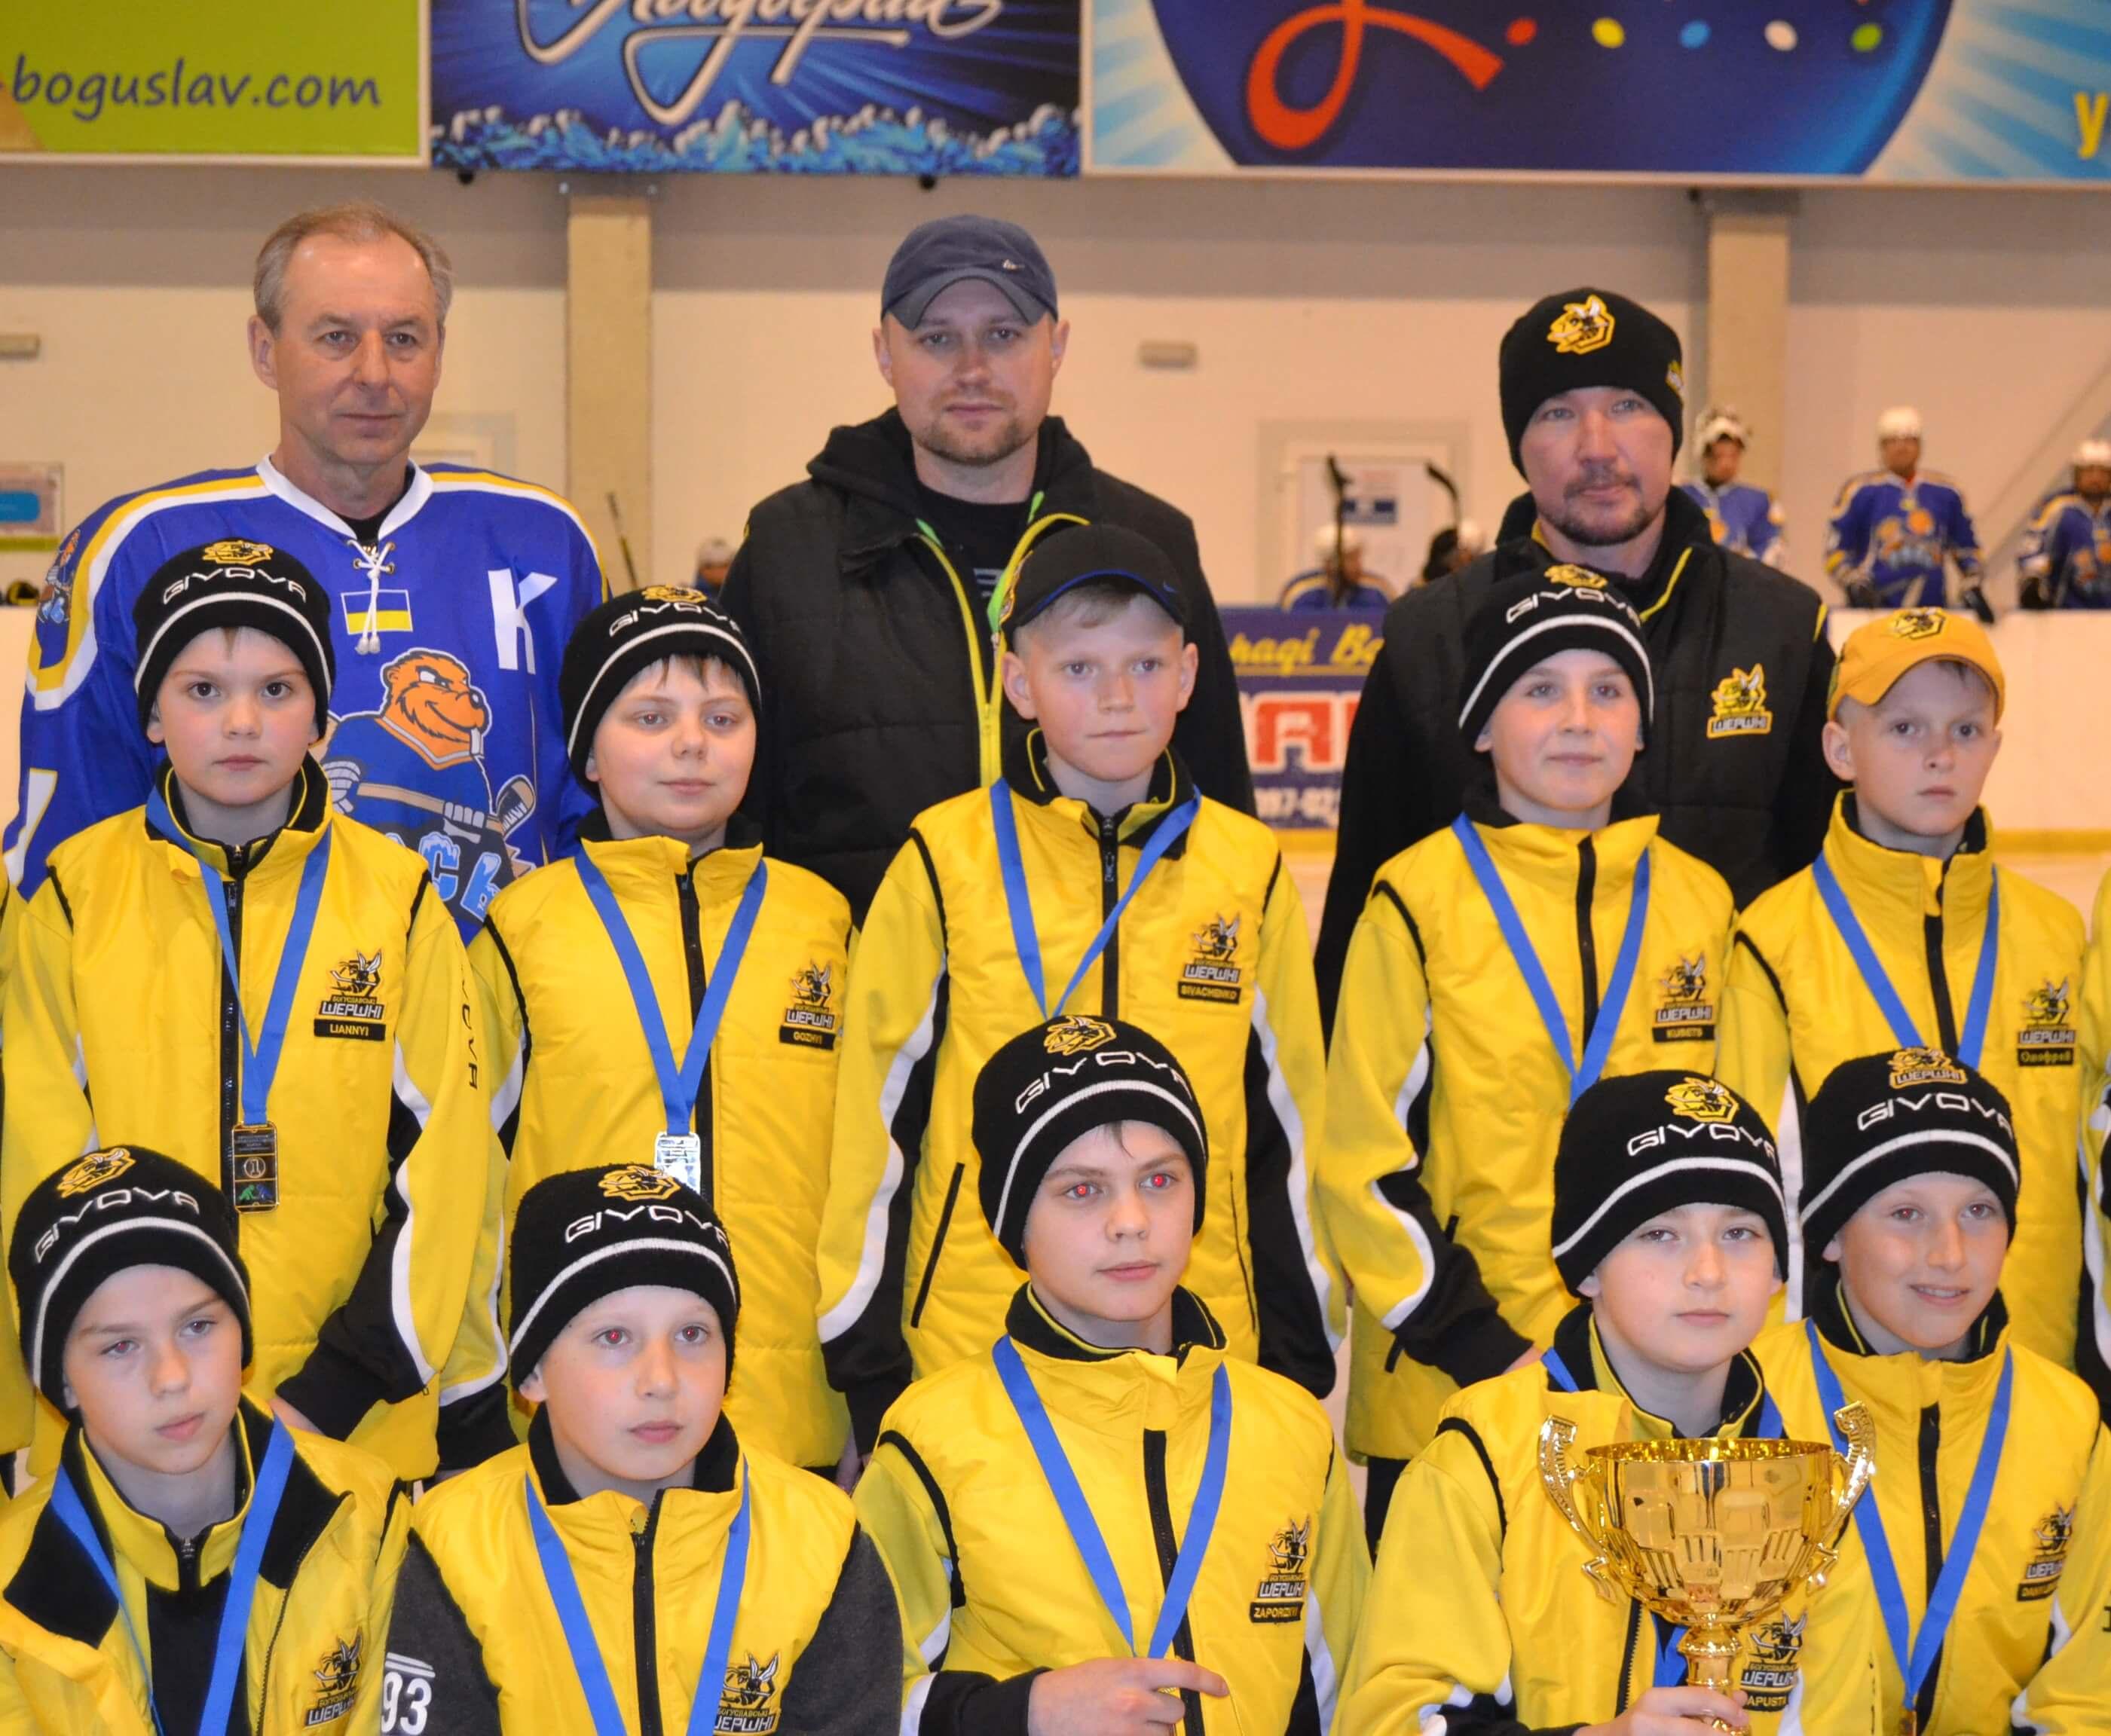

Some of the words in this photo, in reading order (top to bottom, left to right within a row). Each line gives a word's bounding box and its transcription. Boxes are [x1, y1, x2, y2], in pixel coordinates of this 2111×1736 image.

[0, 53, 381, 122] boguslav.com
[164, 567, 307, 604] GIVOVA
[321, 1001, 383, 1019] ШЕРШНІ
[1015, 1051, 1192, 1114] GIVOVA
[1857, 1093, 2014, 1141] GIVOVA
[1627, 1123, 1777, 1167] GIVOVA
[35, 1186, 200, 1264] GIVOVA
[565, 1205, 730, 1243] GIVOVA
[381, 1671, 432, 1735] 93
